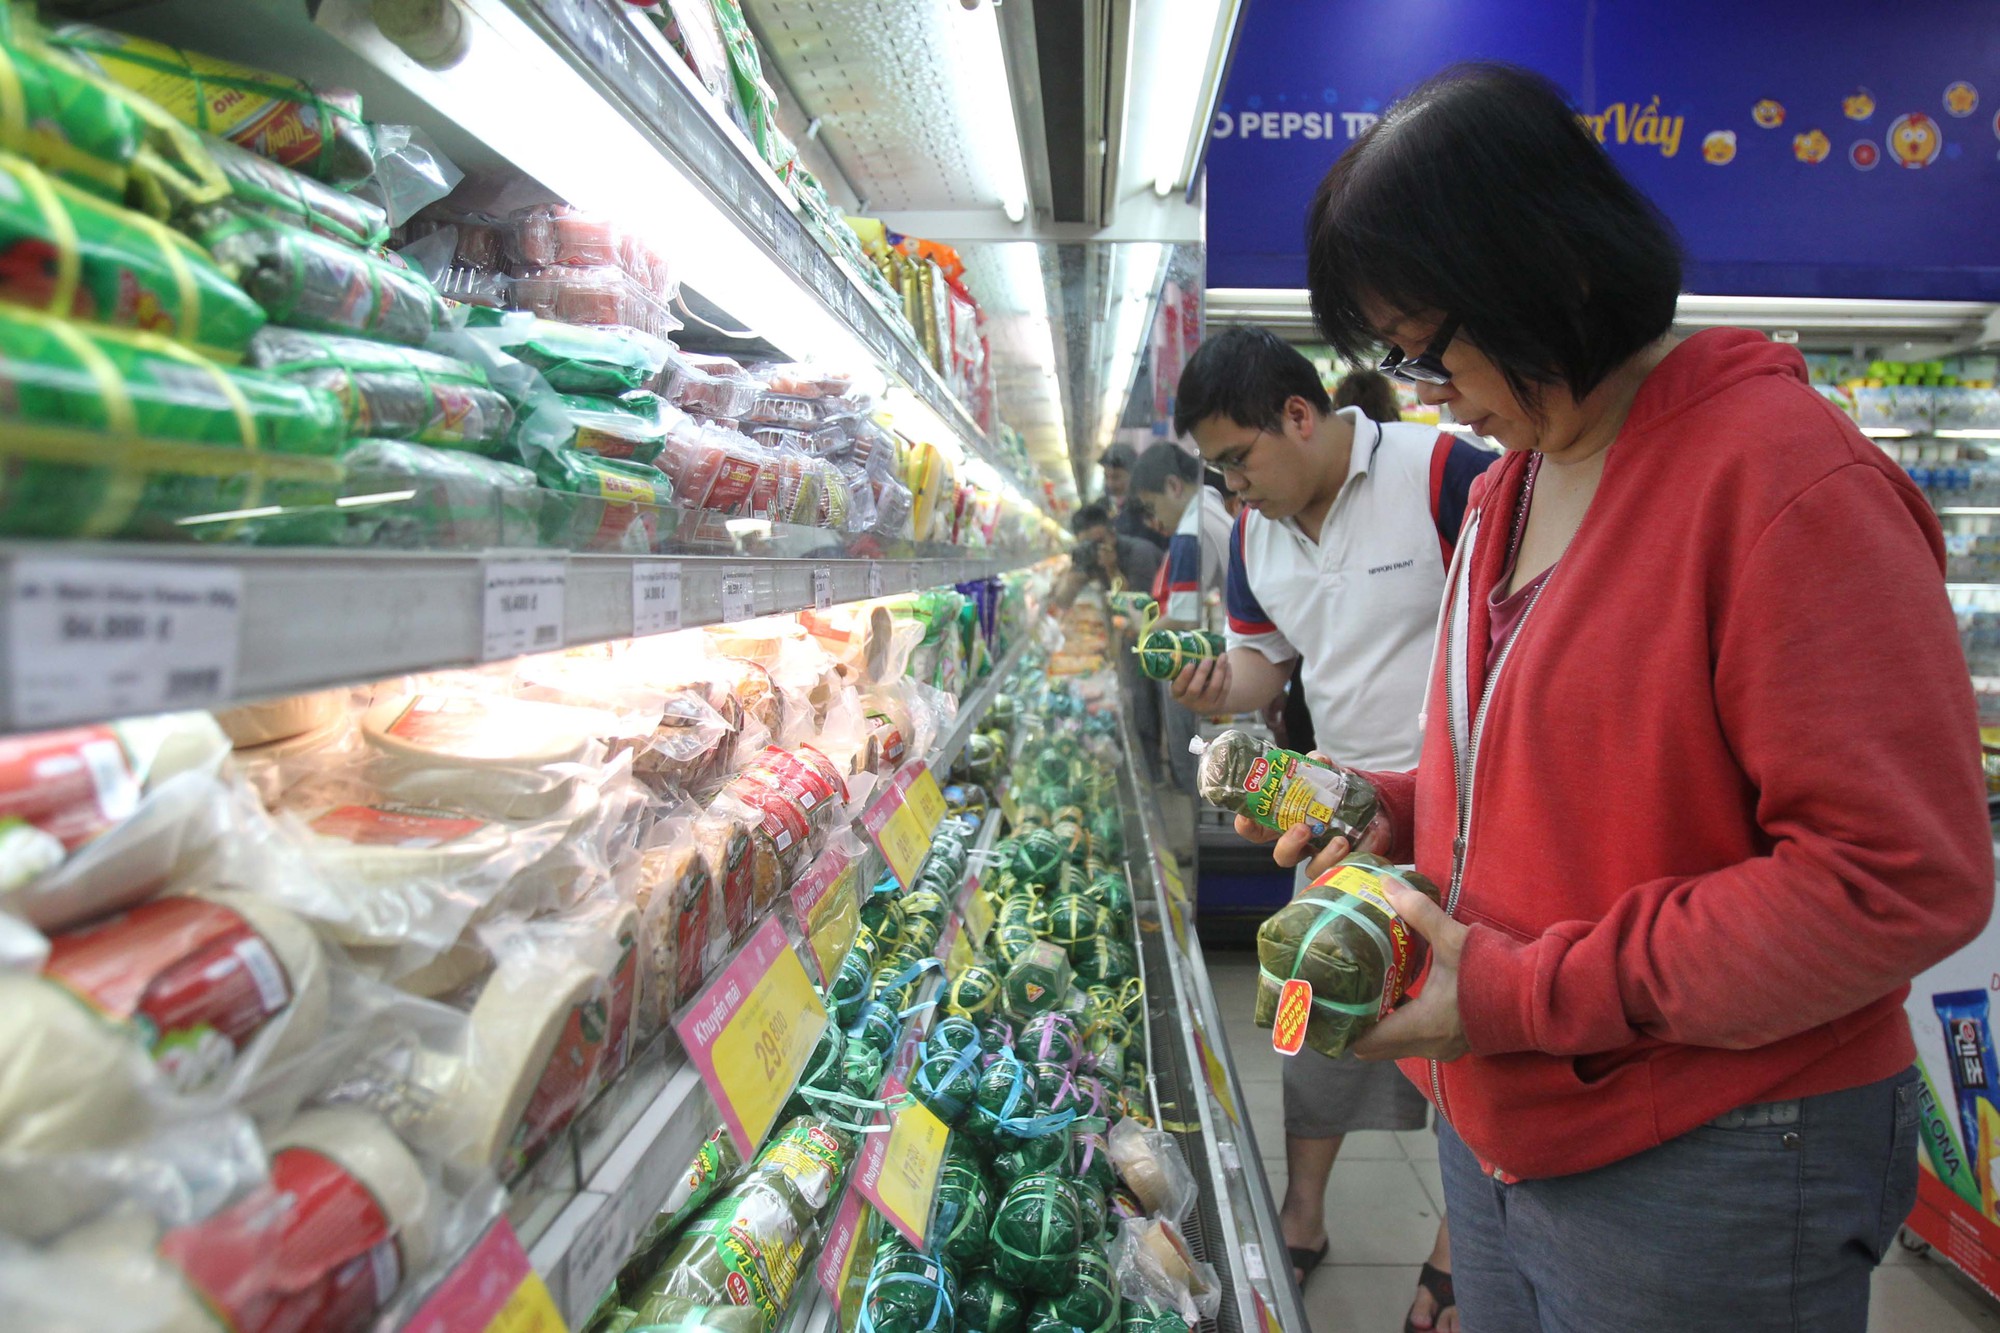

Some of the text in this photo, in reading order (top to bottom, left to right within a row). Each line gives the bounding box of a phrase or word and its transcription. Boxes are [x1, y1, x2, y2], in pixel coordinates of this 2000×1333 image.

[1239, 112, 1333, 140] PEPSI
[1393, 559, 1413, 571] PAINT
[692, 979, 742, 1047] Khuyến mãi
[861, 1153, 882, 1190] Khuyến
[824, 1223, 850, 1289] Khuyến mãi
